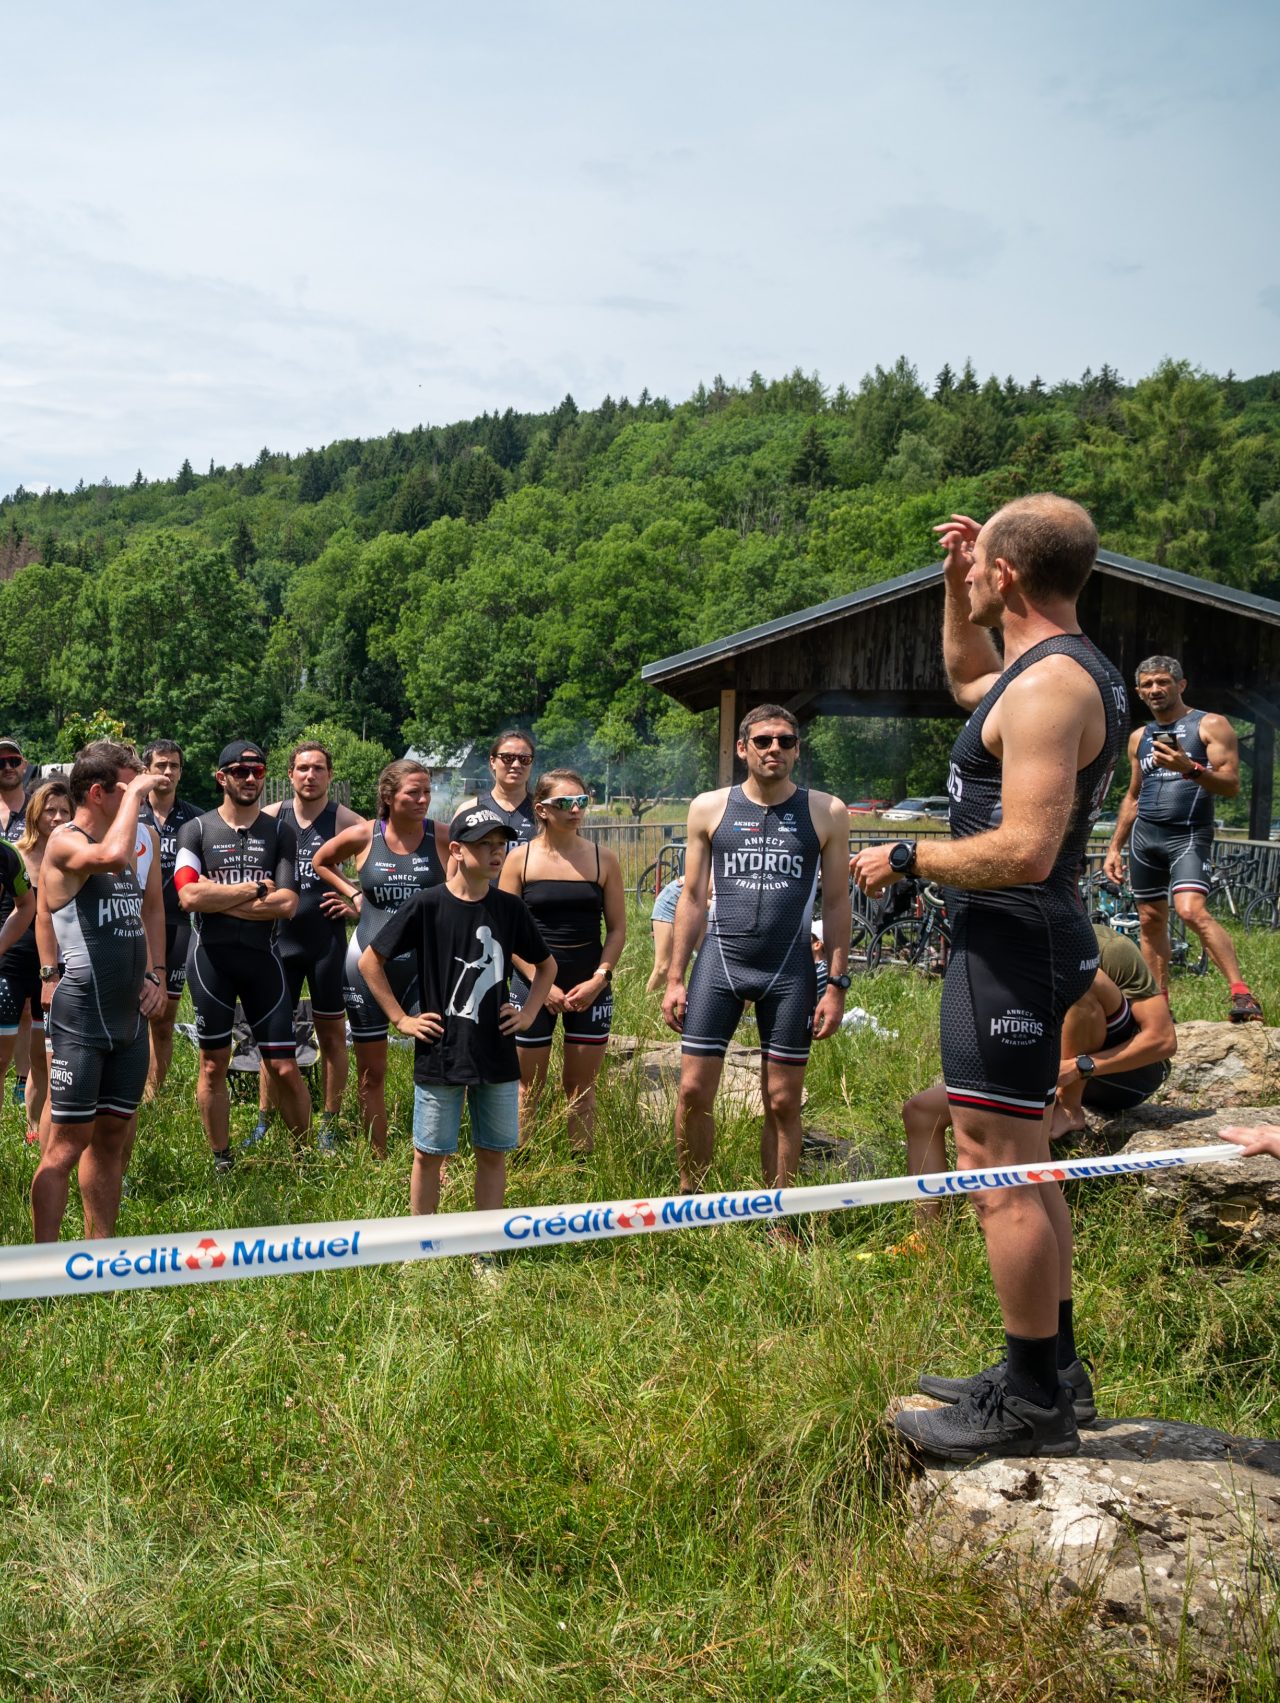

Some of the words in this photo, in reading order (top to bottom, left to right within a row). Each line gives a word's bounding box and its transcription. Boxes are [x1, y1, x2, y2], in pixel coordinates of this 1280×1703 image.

[744, 837, 785, 846] ANNECY
[223, 855, 259, 864] ANNECY
[723, 853, 803, 878] HYDROS
[736, 879, 788, 890] TRIATHLON
[373, 886, 422, 903] HYDR
[98, 898, 144, 927] HYDRO
[1007, 1009, 1033, 1018] ANNECY
[990, 1018, 1043, 1036] HYDROS
[503, 1206, 616, 1240] Crédit
[661, 1190, 784, 1224] Mutuel
[65, 1246, 182, 1280] Crédit
[232, 1231, 361, 1266] Mutuel
